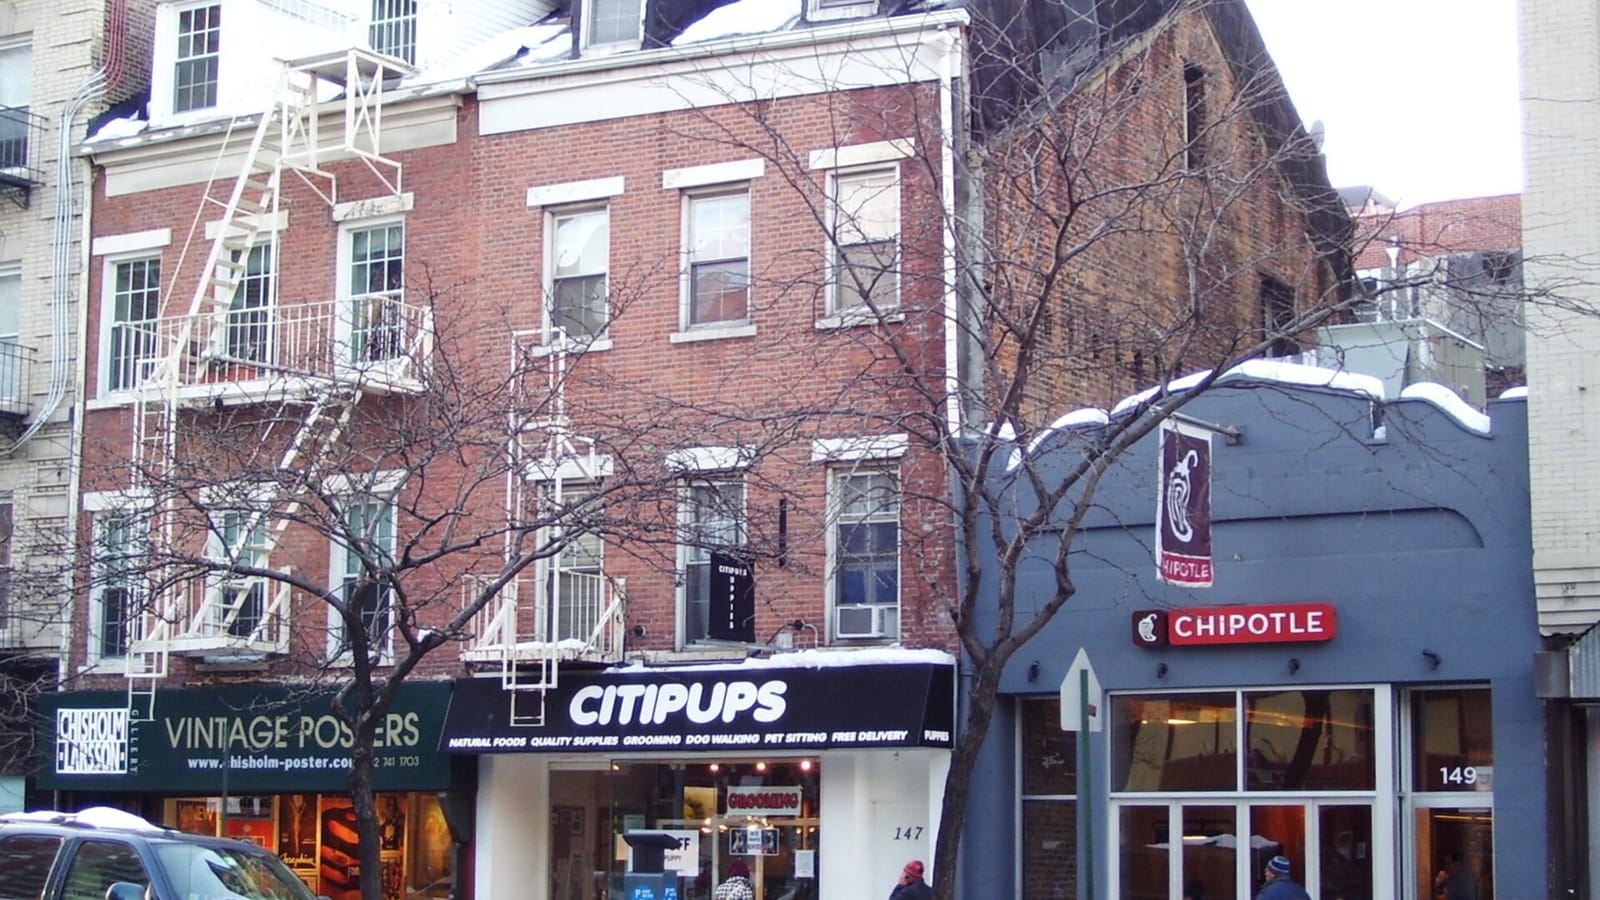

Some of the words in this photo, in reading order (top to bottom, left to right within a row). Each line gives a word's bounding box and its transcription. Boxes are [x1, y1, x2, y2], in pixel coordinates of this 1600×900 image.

[1162, 560, 1209, 578] HIPOTLE
[1174, 611, 1324, 637] CHIPOTLE
[569, 680, 788, 726] CITIPUPS
[60, 711, 127, 741] CHISHOLM
[164, 716, 288, 748] VINTAGE
[299, 712, 420, 749] POSERS
[130, 709, 139, 775] GALLERY
[449, 738, 491, 748] NATURAL
[493, 737, 527, 747] FOODS
[530, 736, 572, 747] QUALITY
[573, 736, 619, 746] SUPPLIES
[623, 735, 681, 745] GROOMING
[685, 735, 710, 745] DOG
[711, 734, 760, 744] WALKING
[764, 733, 785, 743] PET
[785, 733, 827, 743] SITTING
[832, 732, 857, 742] FREE
[858, 731, 908, 742] DELIVERY
[64, 742, 120, 771] LARSSON
[187, 755, 353, 771] www.hisholm-poster.co
[383, 757, 395, 768] 741
[399, 756, 420, 767] 1703
[1440, 766, 1477, 785] 149
[894, 826, 924, 840] 147
